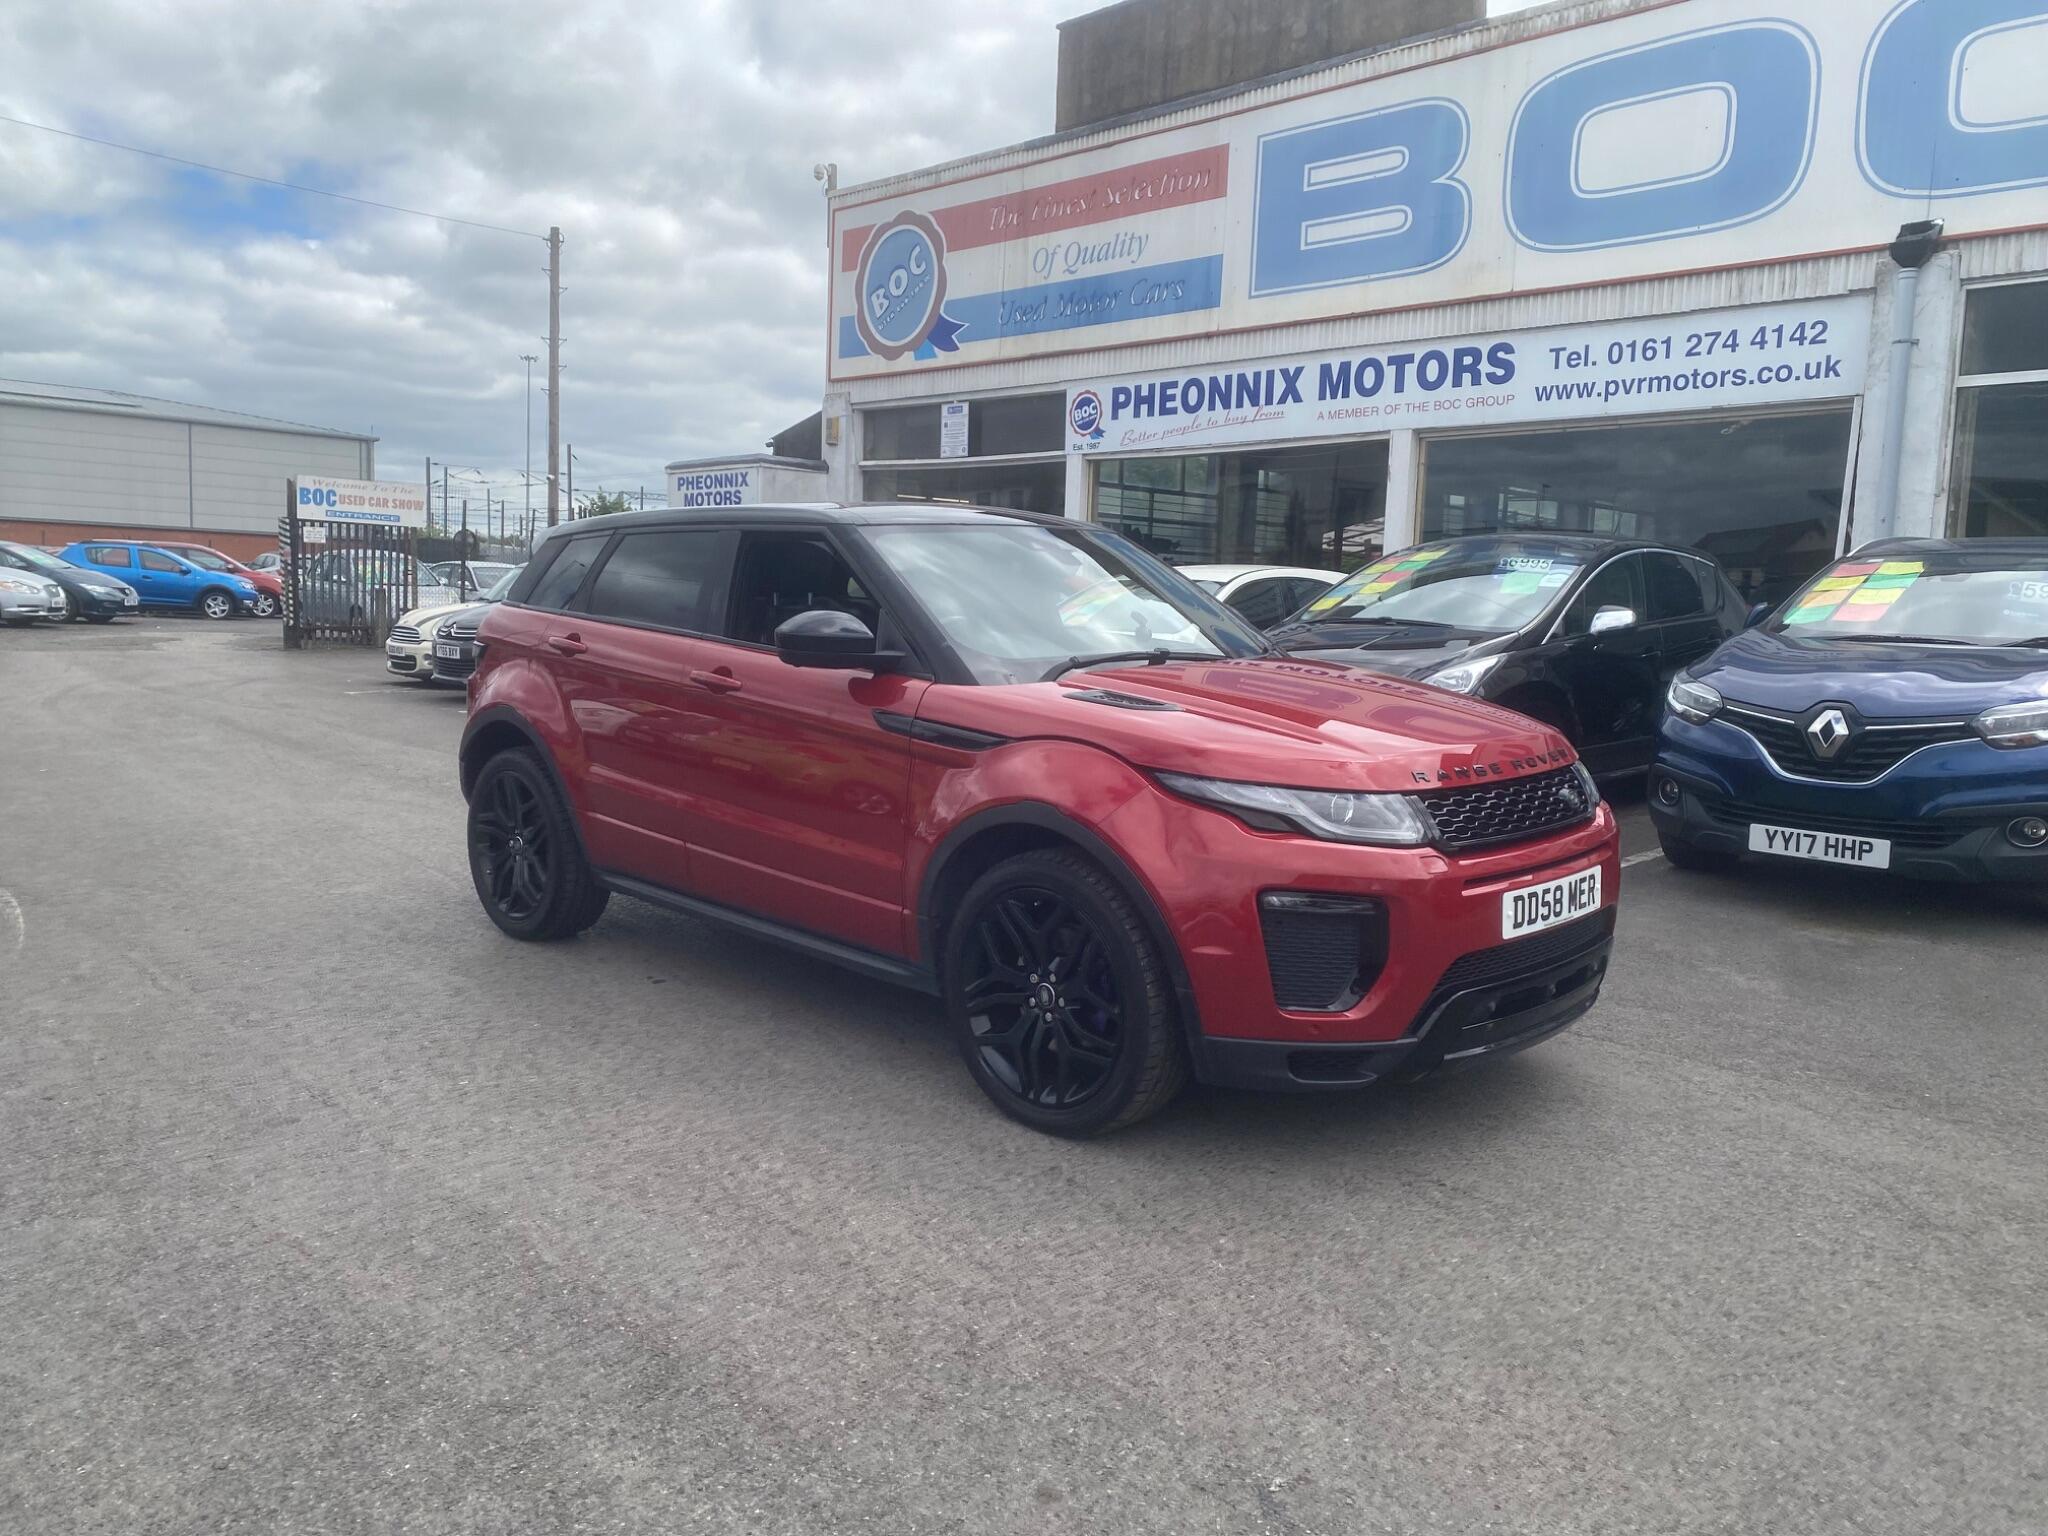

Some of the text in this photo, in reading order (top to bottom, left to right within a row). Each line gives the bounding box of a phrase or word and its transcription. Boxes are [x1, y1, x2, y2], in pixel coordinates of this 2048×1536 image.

[1102, 168, 1211, 208] Selection
[1033, 231, 1149, 280] Of Quality
[870, 244, 927, 319] BOC
[999, 277, 1186, 326] Used Motor Cars
[1549, 319, 1829, 370] Tel. 0161 274 4142
[1111, 342, 1516, 420] PHEONNIX MOTORS
[1534, 355, 1842, 402] www.pvrmotors.co.uk
[1074, 402, 1097, 421] BOC
[1120, 404, 1284, 446] Better people to buy from
[1317, 394, 1516, 421] A MEMBER OF THE BOC GROUP
[299, 487, 425, 511] BOC USED CAR SHOW
[312, 479, 368, 490] Welcome
[677, 472, 749, 491] PHEONNIX
[684, 490, 742, 507] MOTORS
[327, 511, 400, 522] ENTRANCE
[1411, 747, 1569, 783] RANGE ROVER
[1765, 828, 1874, 861] YY17 HHP
[1513, 873, 1597, 930] DD58 MER
